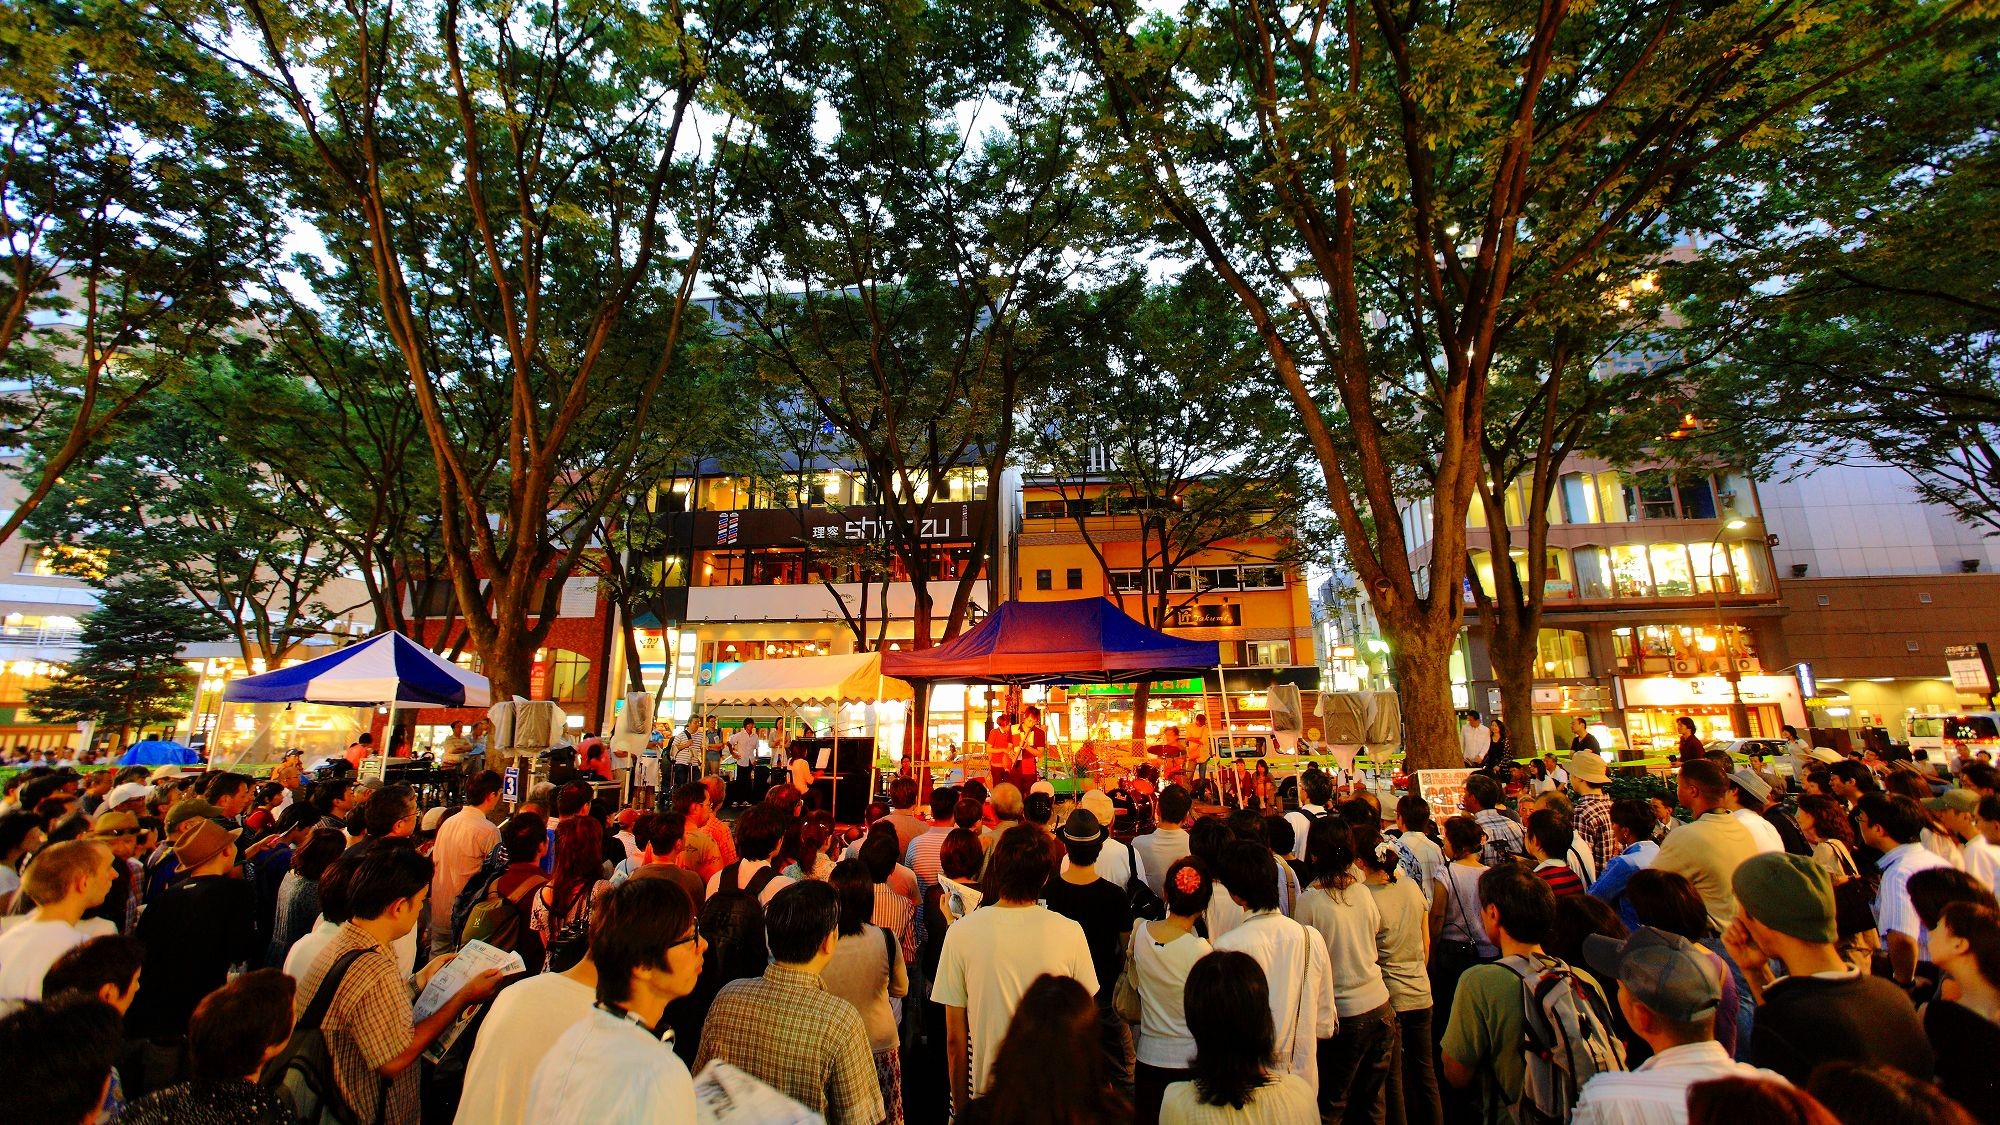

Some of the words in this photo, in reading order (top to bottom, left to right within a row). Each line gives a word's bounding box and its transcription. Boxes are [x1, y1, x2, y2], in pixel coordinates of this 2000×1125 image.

[812, 525, 839, 539] 理容
[845, 515, 950, 540] shizu
[1178, 607, 1198, 626] 匠
[506, 777, 514, 795] 3
